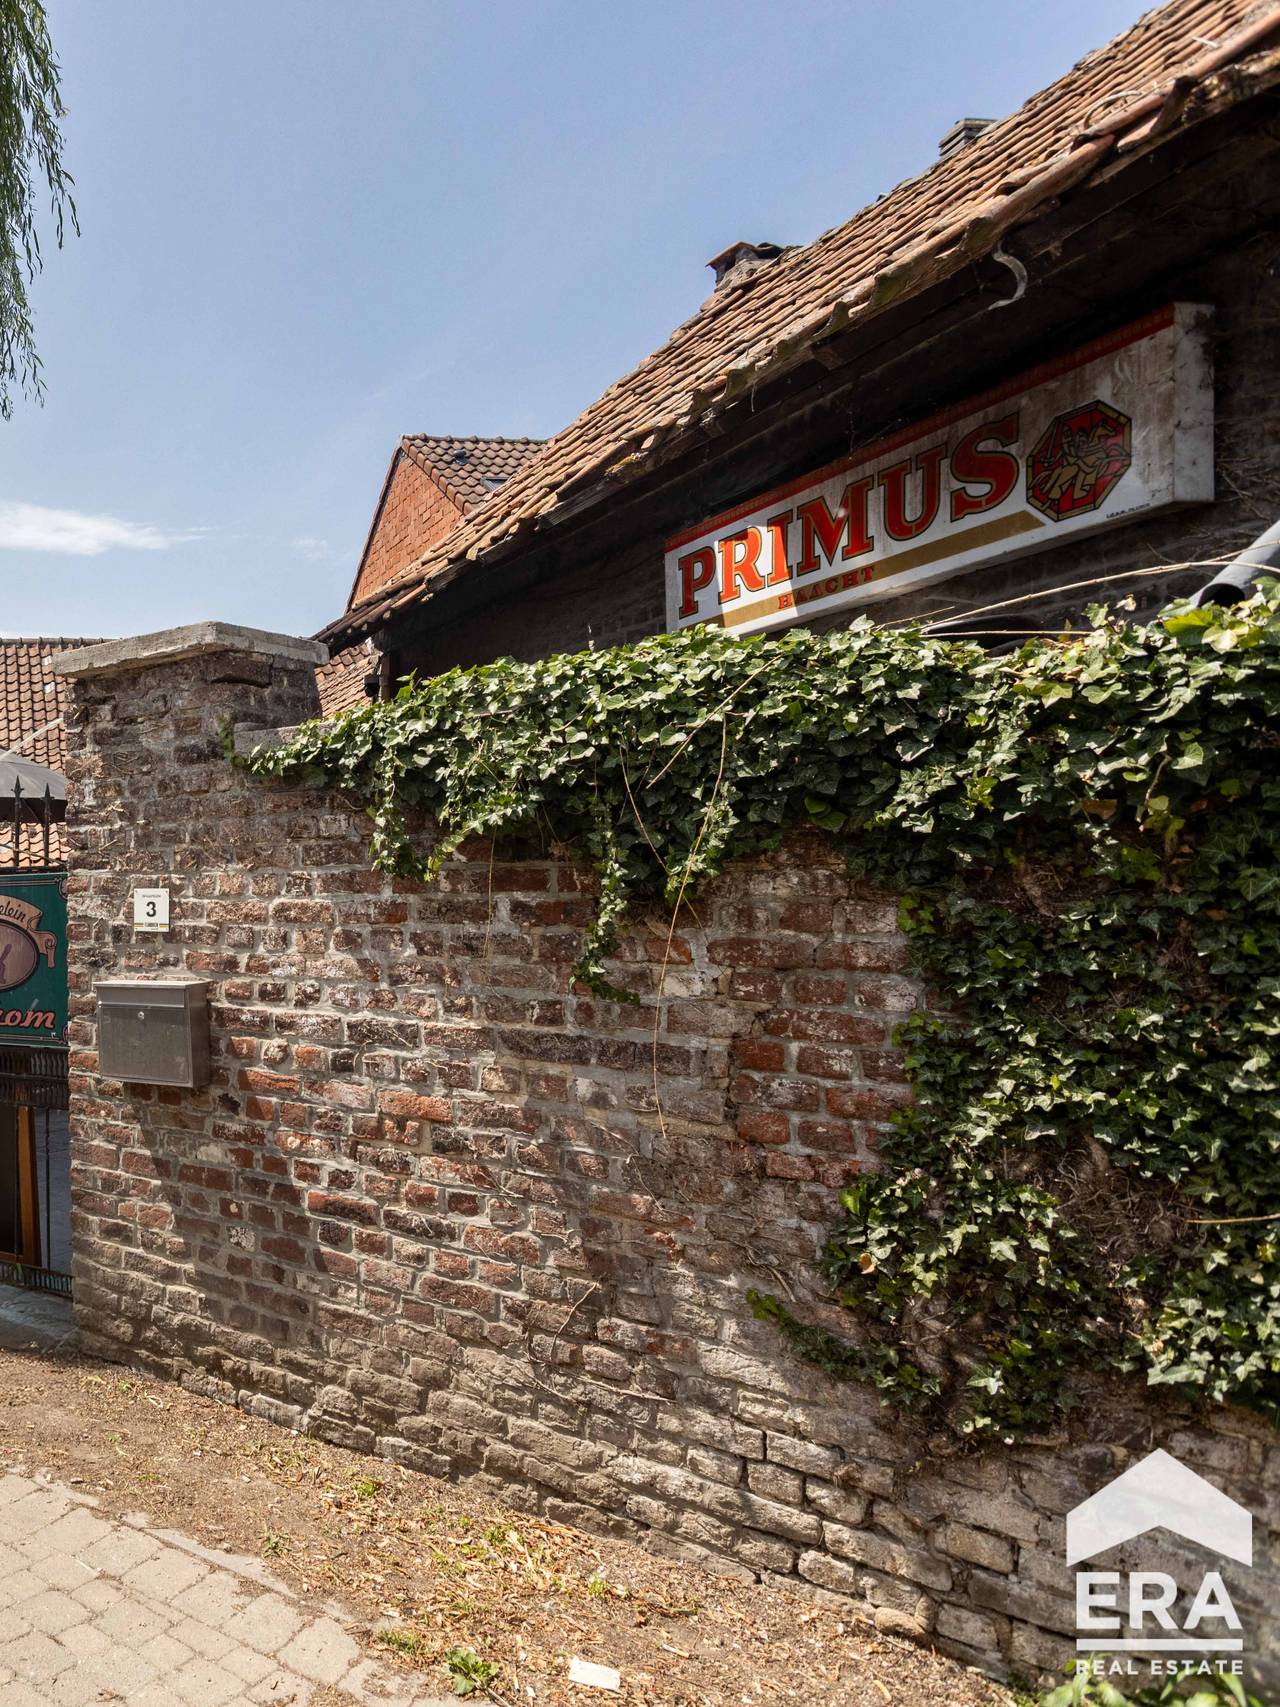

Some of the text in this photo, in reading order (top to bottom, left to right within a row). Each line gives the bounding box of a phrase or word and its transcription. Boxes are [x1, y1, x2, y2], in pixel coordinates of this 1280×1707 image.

[678, 411, 1019, 619] PRIMUS
[778, 565, 874, 609] HAACHT
[146, 901, 157, 917] 3
